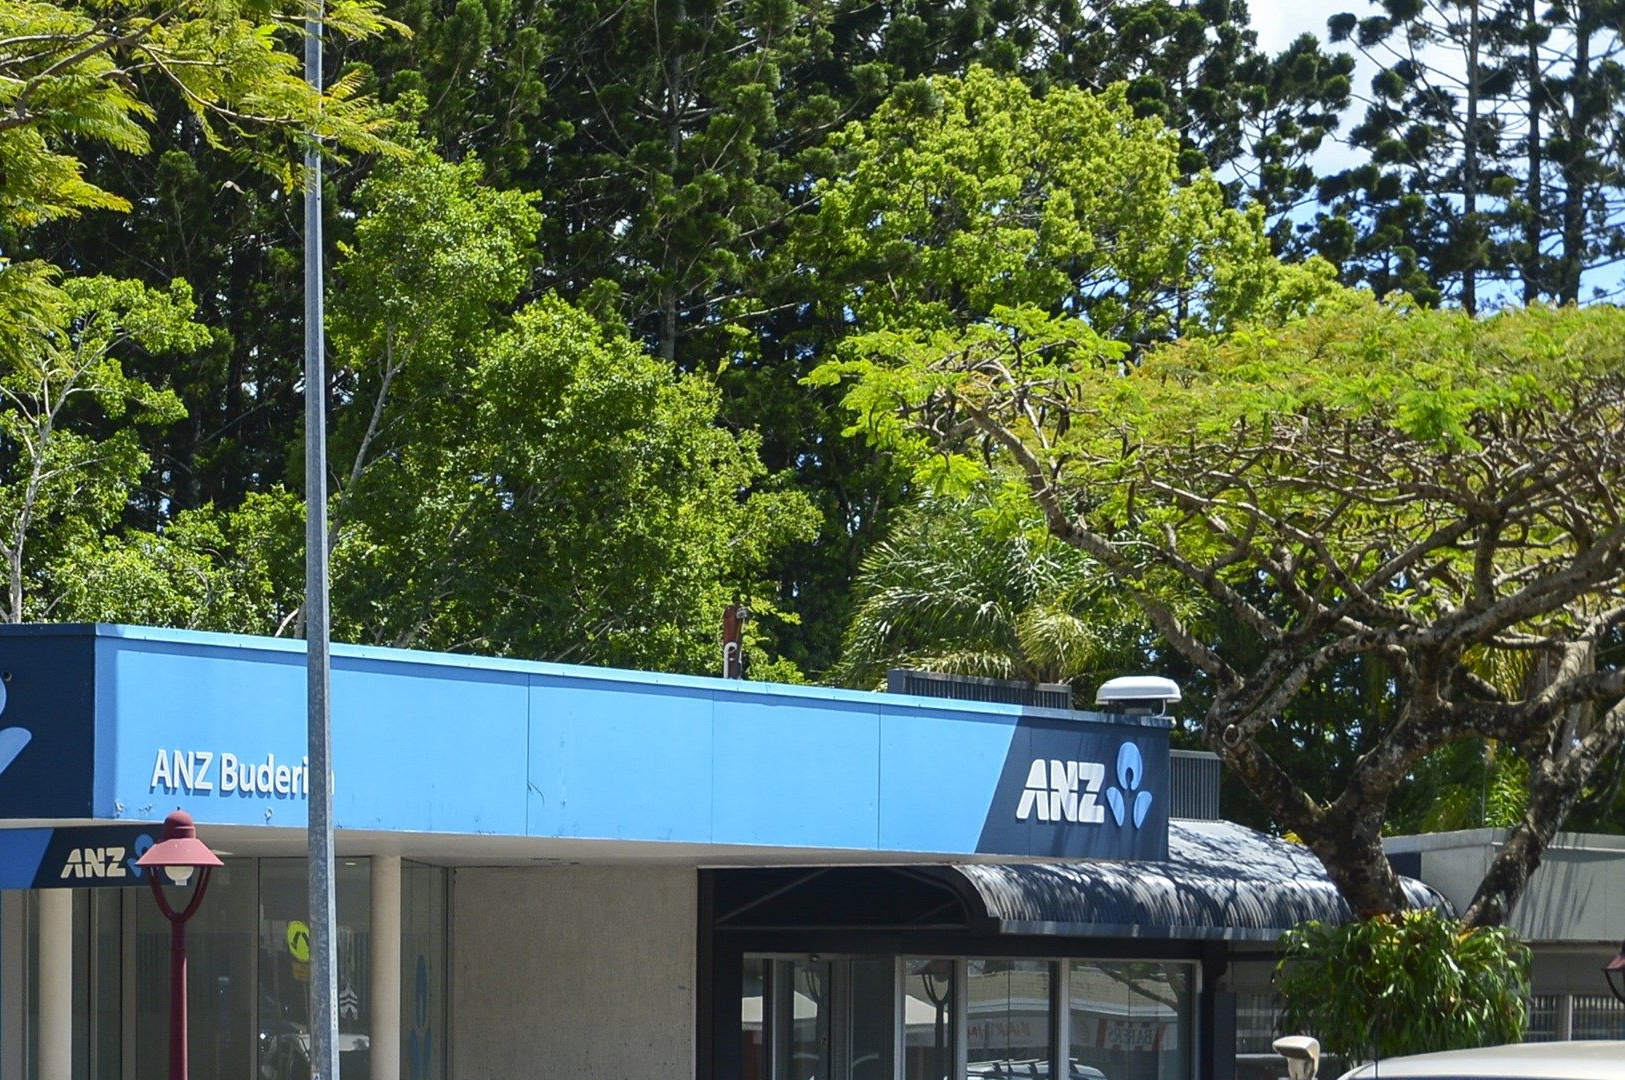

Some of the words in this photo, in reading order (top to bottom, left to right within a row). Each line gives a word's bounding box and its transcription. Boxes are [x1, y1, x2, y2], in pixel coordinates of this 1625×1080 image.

[151, 748, 214, 795] ANZ
[221, 752, 335, 799] Buderi
[1016, 759, 1105, 823] ANZ
[60, 847, 126, 878] ANZ
